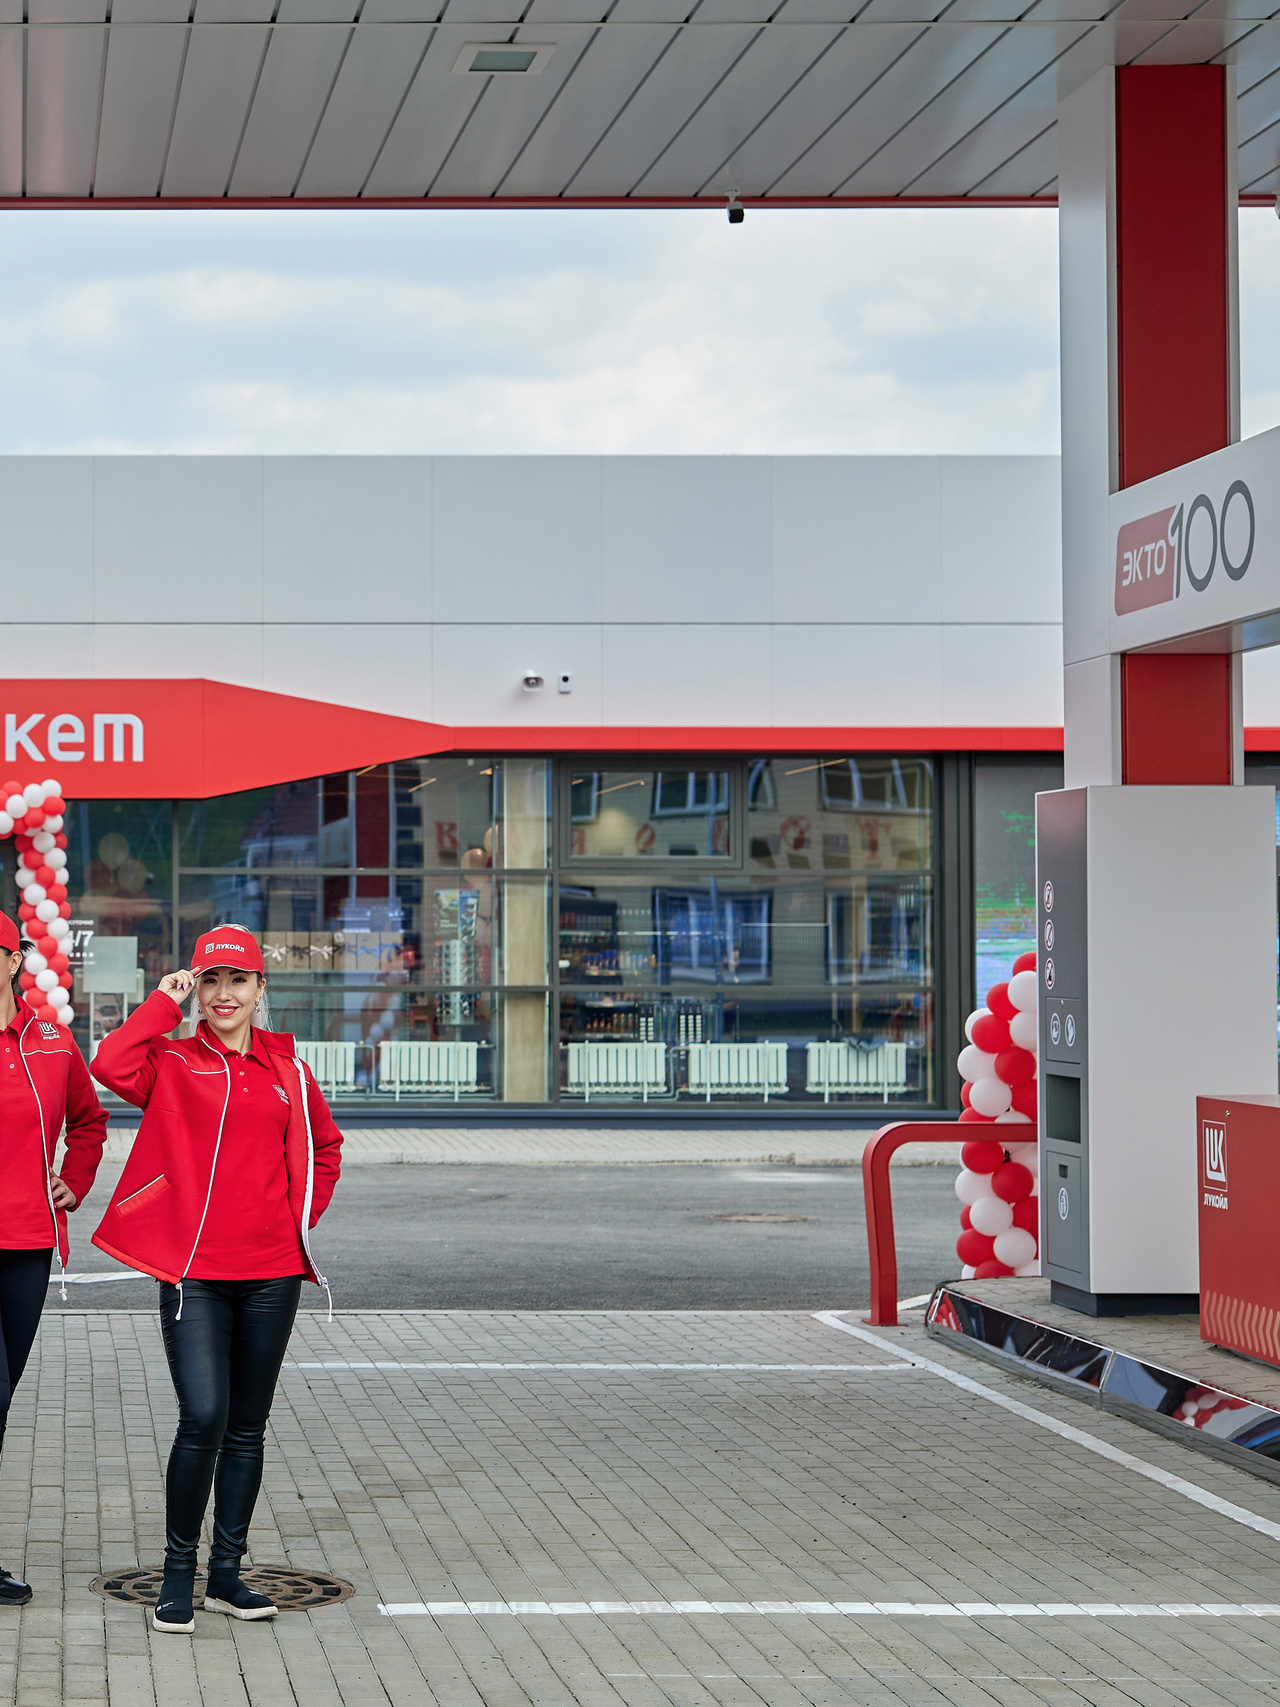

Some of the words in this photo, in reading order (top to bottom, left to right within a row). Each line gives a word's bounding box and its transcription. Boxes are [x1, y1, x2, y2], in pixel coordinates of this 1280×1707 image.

[1121, 538, 1167, 587] ЭКТО
[1170, 479, 1255, 599] 100
[215, 943, 245, 953] ЛУКОЙЛ
[1204, 1193, 1229, 1210] ЛУКОЙЛ
